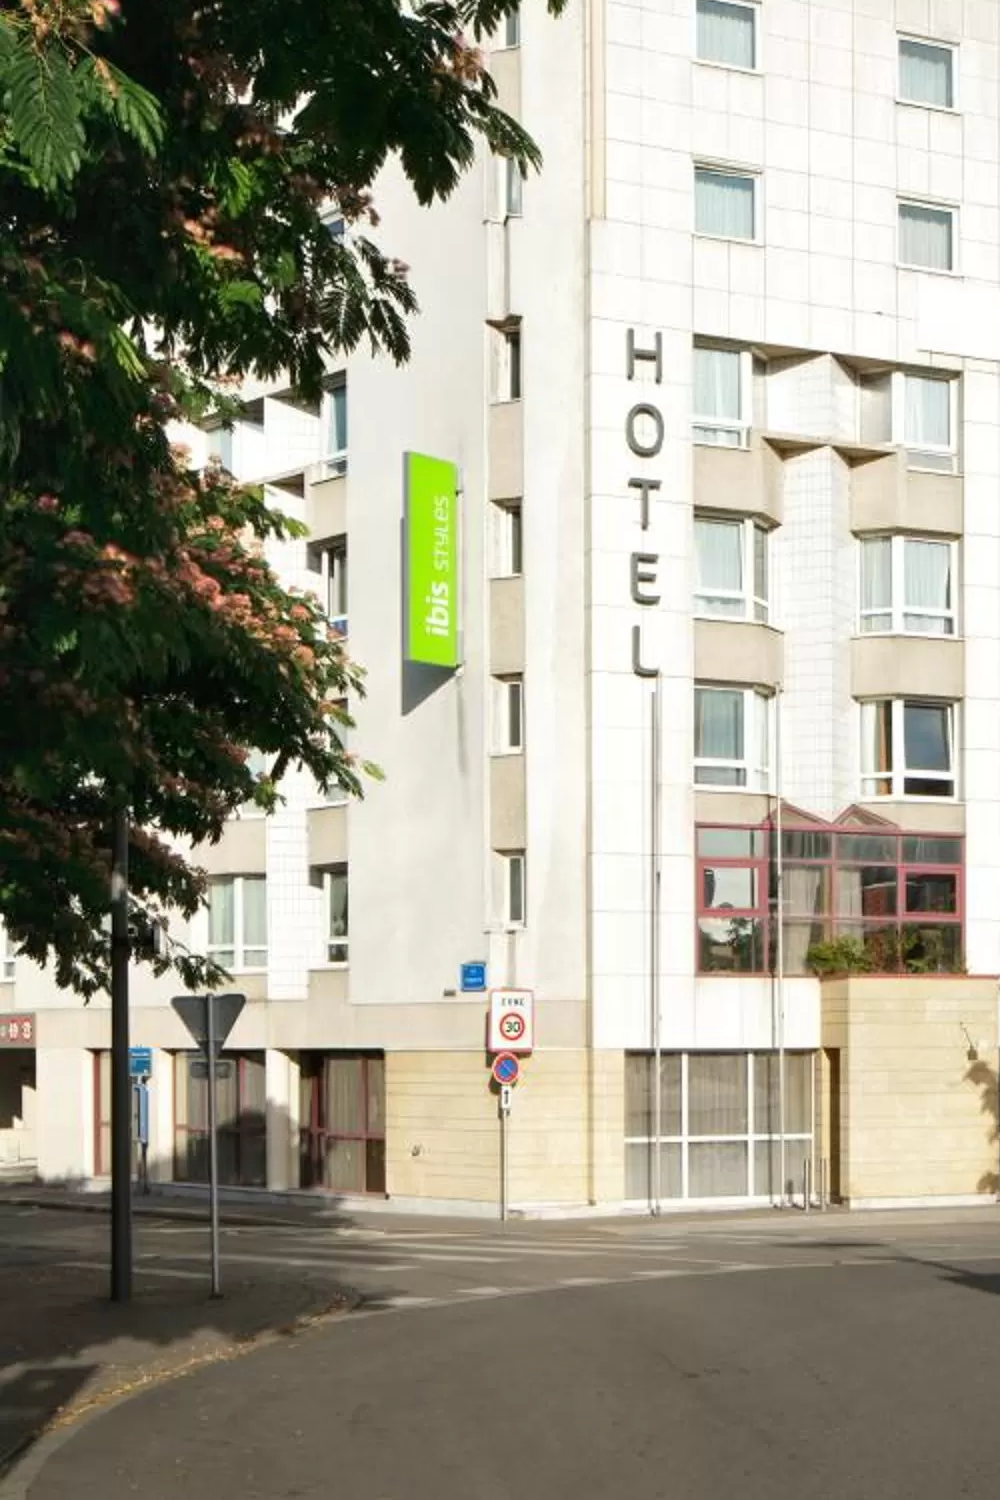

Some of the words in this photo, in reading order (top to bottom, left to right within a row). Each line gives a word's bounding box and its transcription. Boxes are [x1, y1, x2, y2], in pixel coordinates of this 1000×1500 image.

[625, 327, 665, 679] HOTEL
[425, 581, 450, 637] ibis
[505, 1021, 521, 1033] 30
